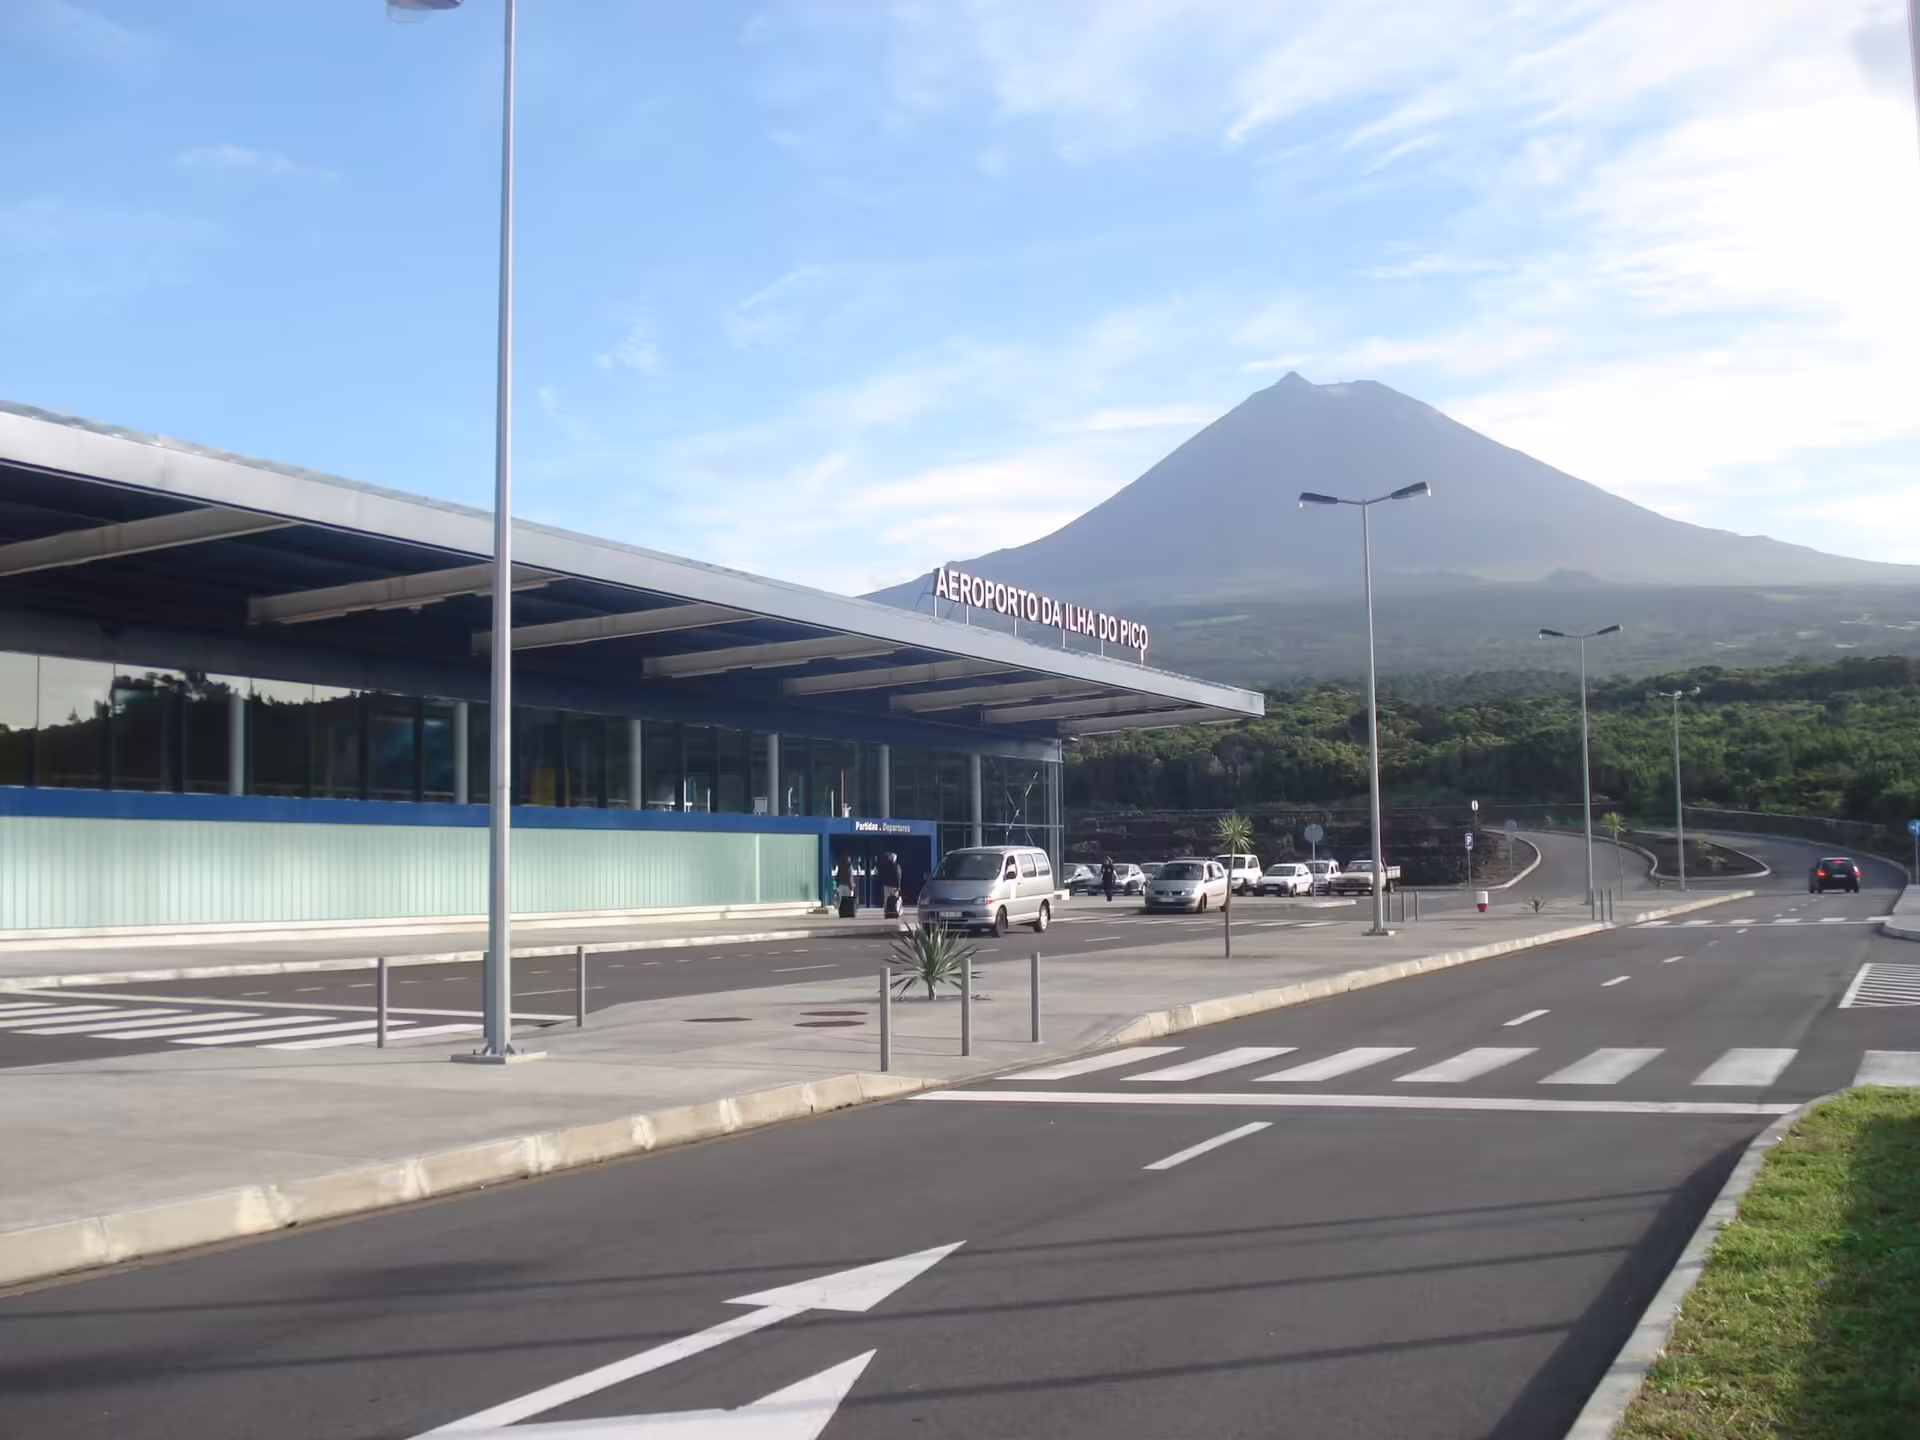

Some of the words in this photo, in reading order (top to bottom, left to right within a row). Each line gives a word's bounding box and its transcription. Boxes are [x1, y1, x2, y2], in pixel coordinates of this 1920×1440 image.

[935, 567, 1038, 622] AEROPORTO
[1042, 596, 1062, 629] DA
[1065, 602, 1096, 637] ILHA
[1099, 613, 1118, 642] DO
[1120, 619, 1149, 650] PICO
[855, 821, 878, 831] Partidas
[882, 822, 911, 833] Departures
